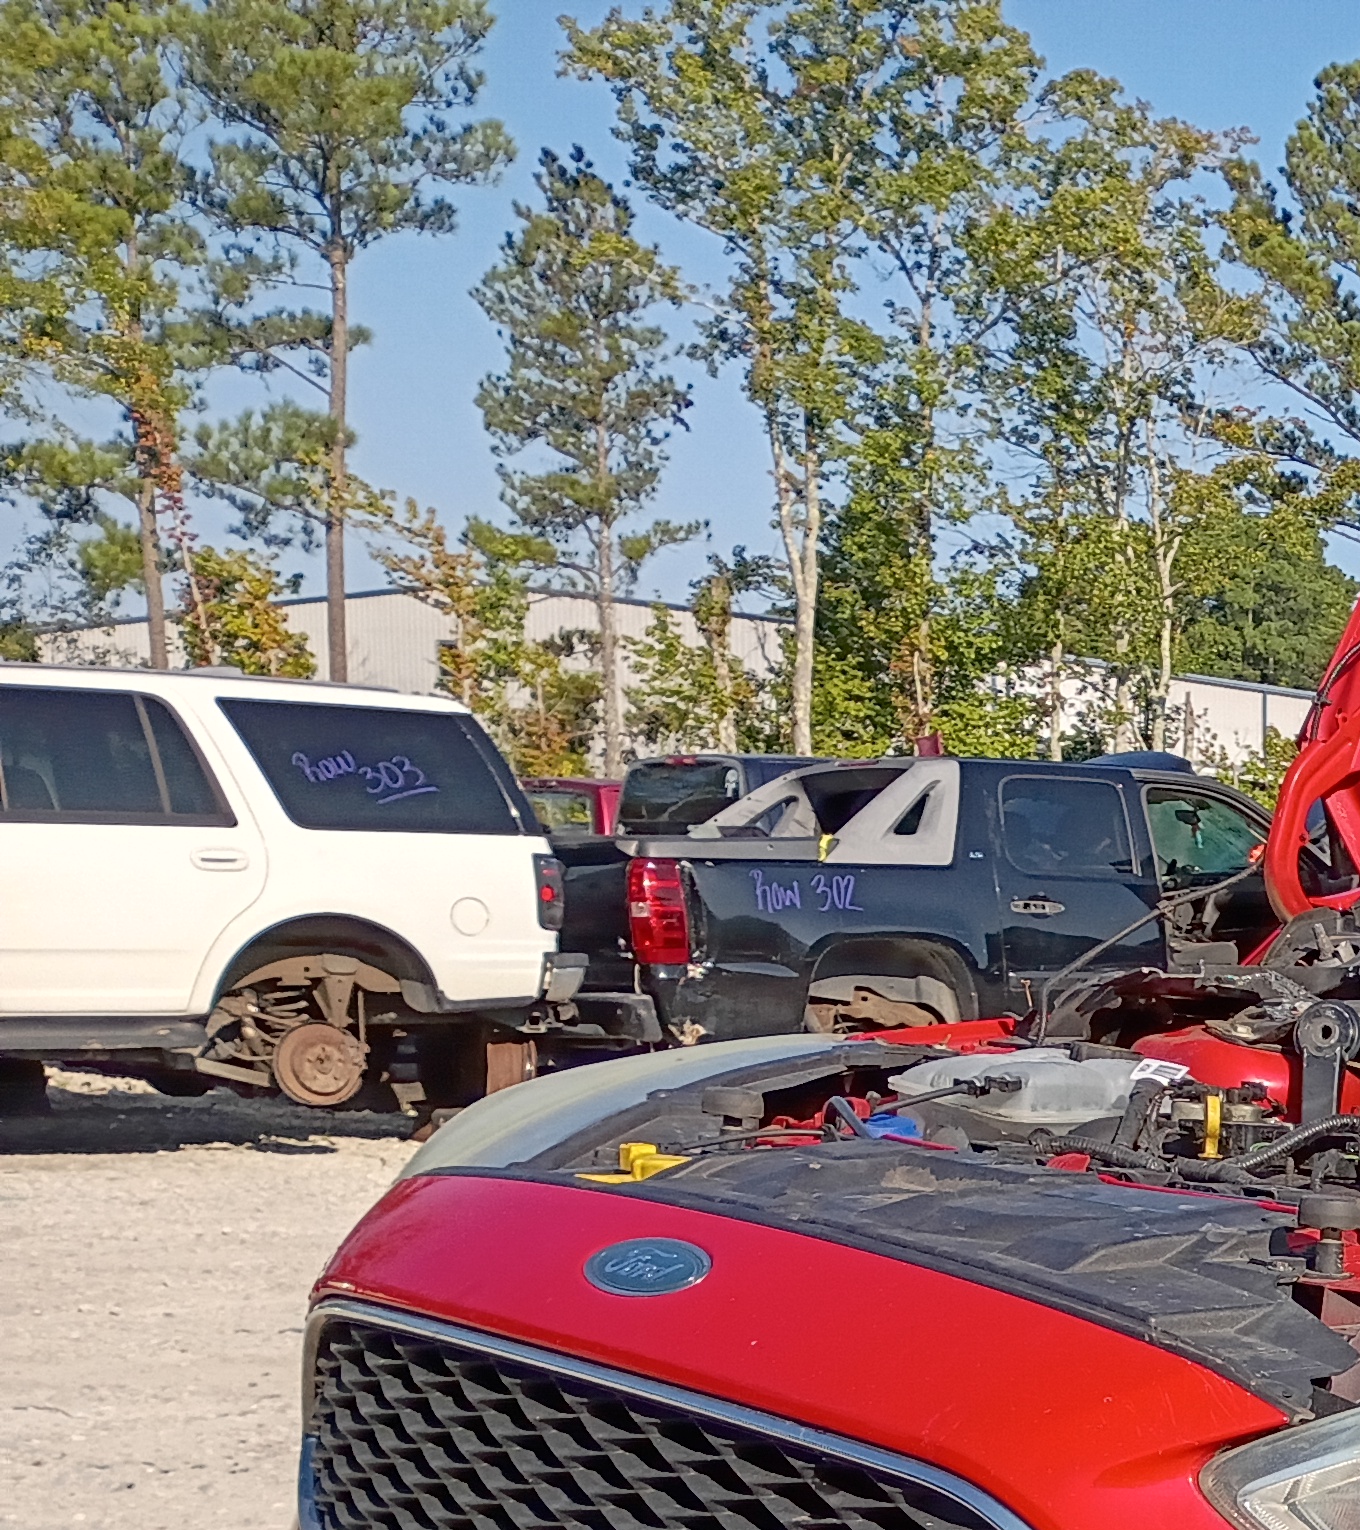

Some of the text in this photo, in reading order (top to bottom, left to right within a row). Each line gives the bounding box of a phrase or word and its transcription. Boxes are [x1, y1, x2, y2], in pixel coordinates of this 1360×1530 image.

[358, 756, 426, 794] 303
[748, 869, 864, 913] Row 302
[604, 1246, 684, 1283] Ford
